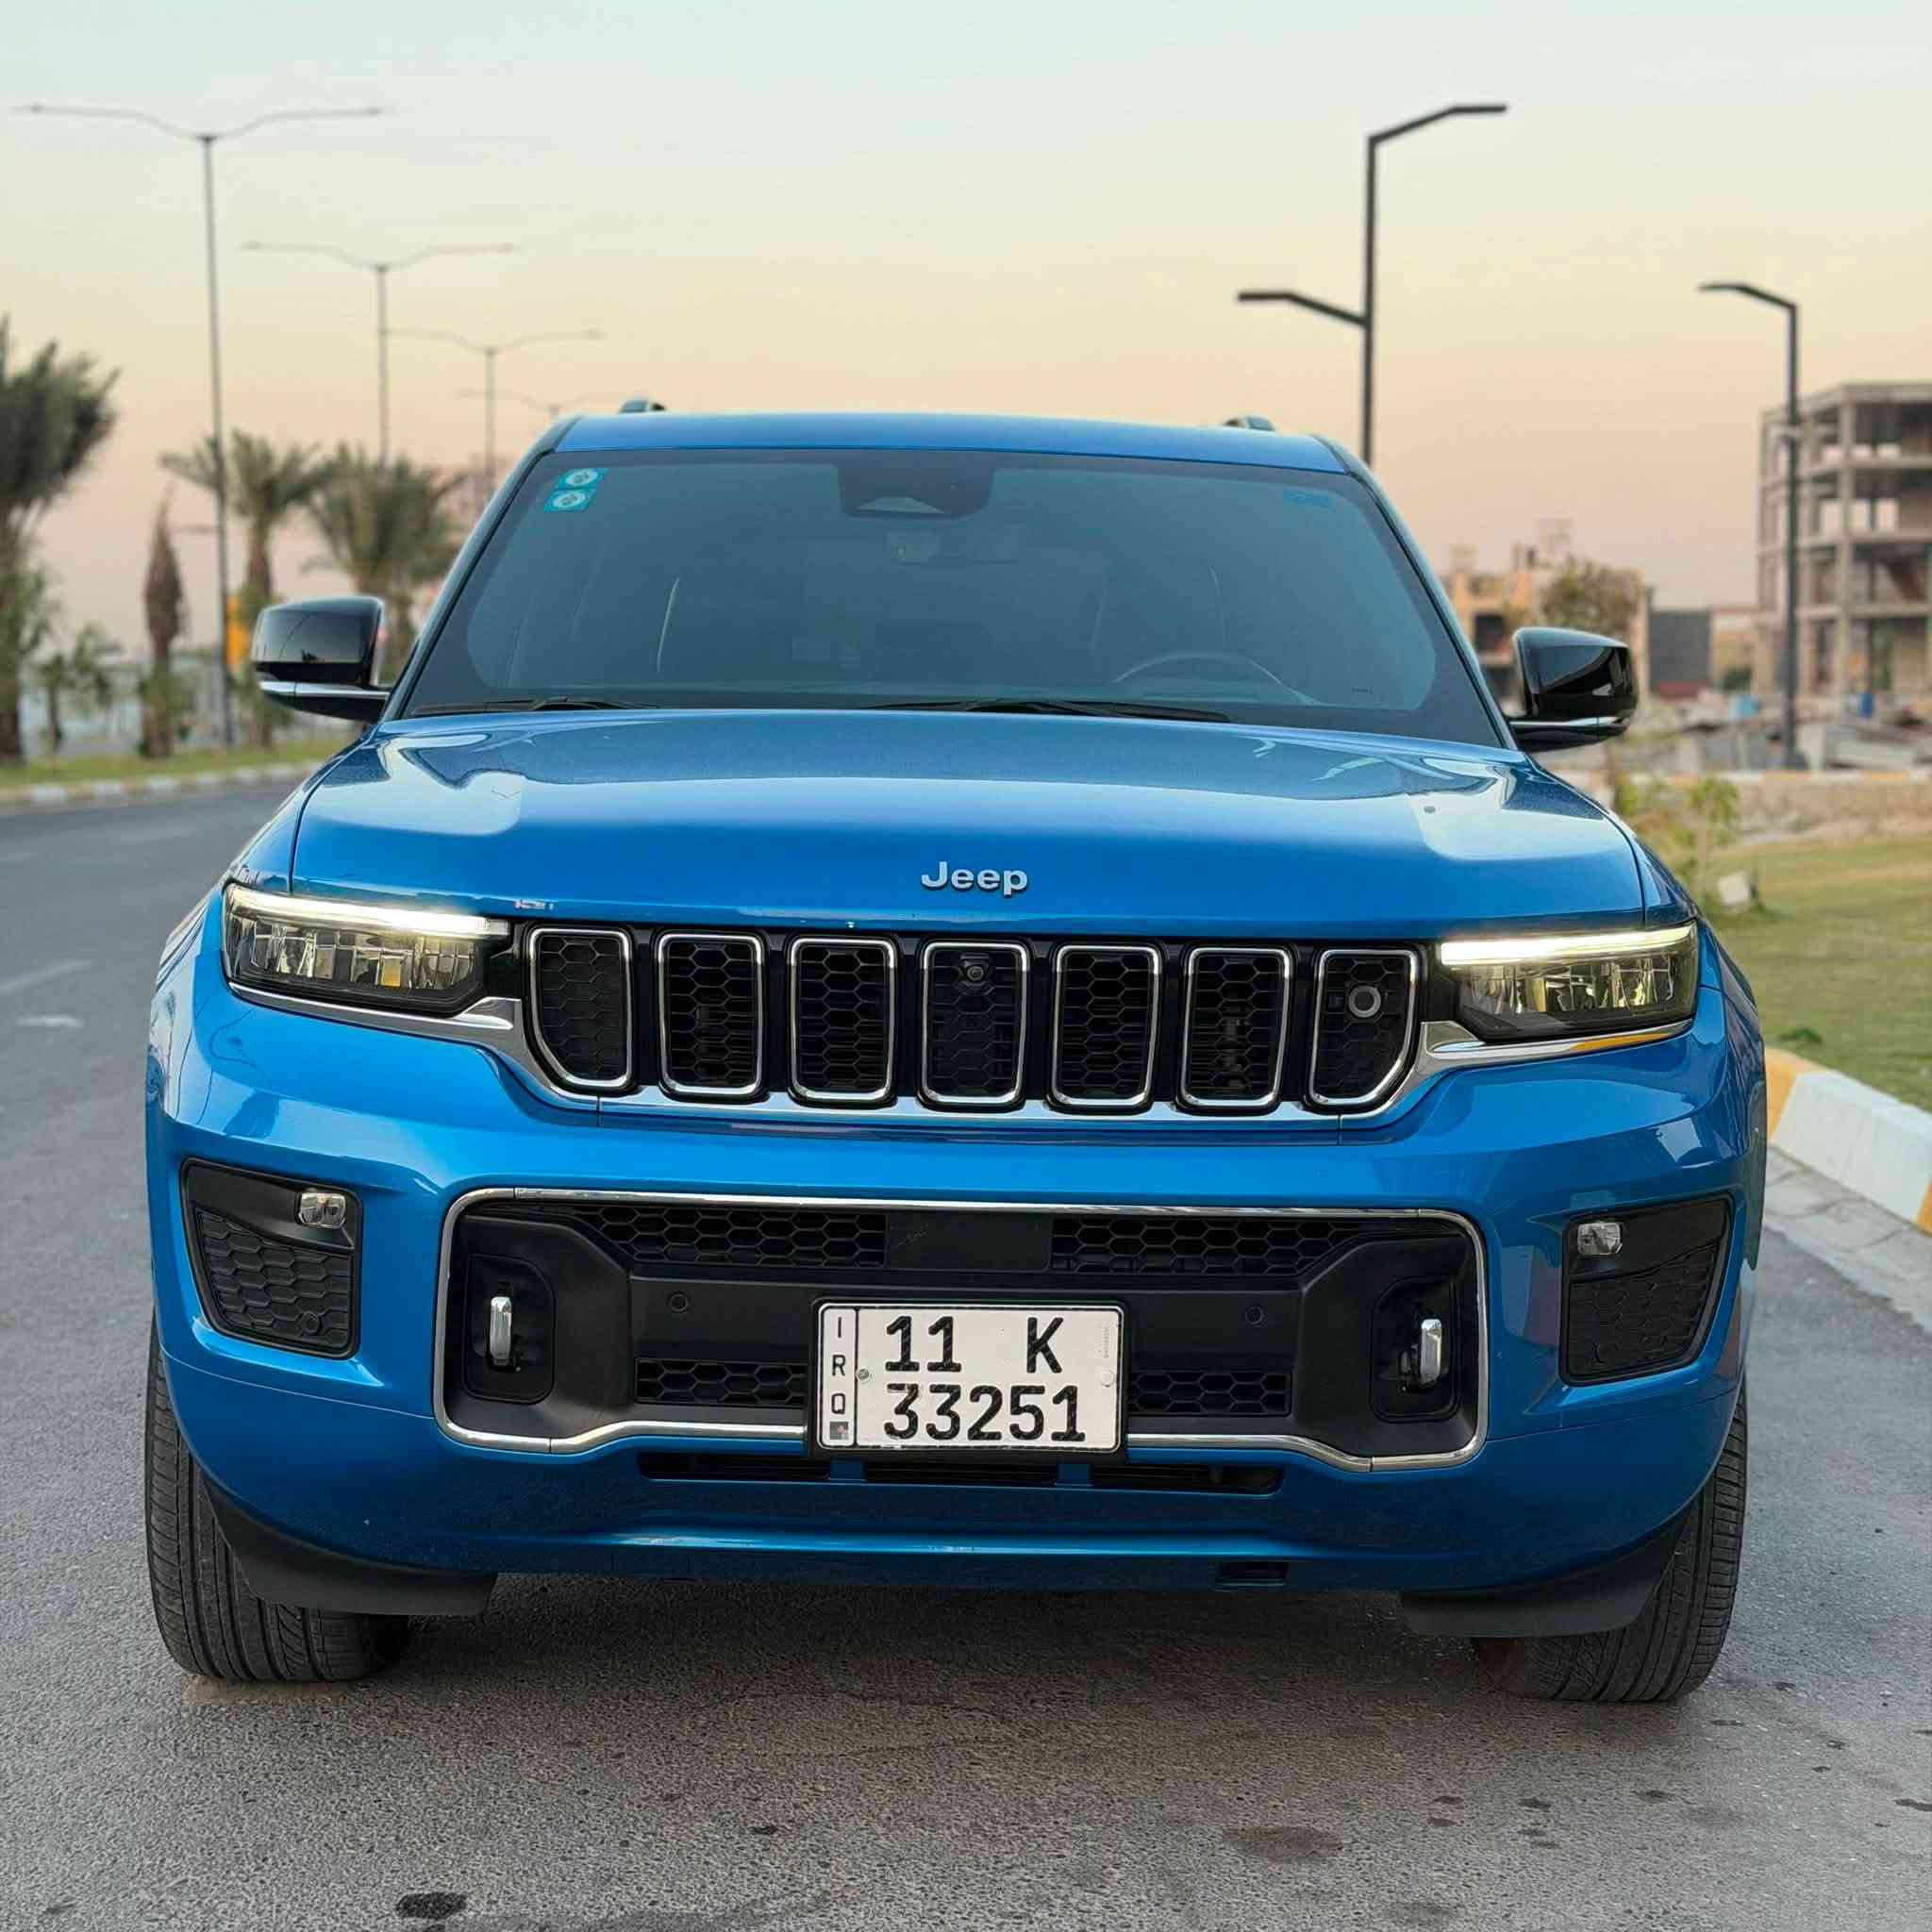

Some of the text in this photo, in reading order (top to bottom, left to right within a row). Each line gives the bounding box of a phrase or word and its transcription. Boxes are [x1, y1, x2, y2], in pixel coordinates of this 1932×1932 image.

[921, 860, 1028, 895] Jeep
[885, 1315, 962, 1373] 11
[1026, 1317, 1064, 1374] K
[884, 1383, 1086, 1442] 33251
